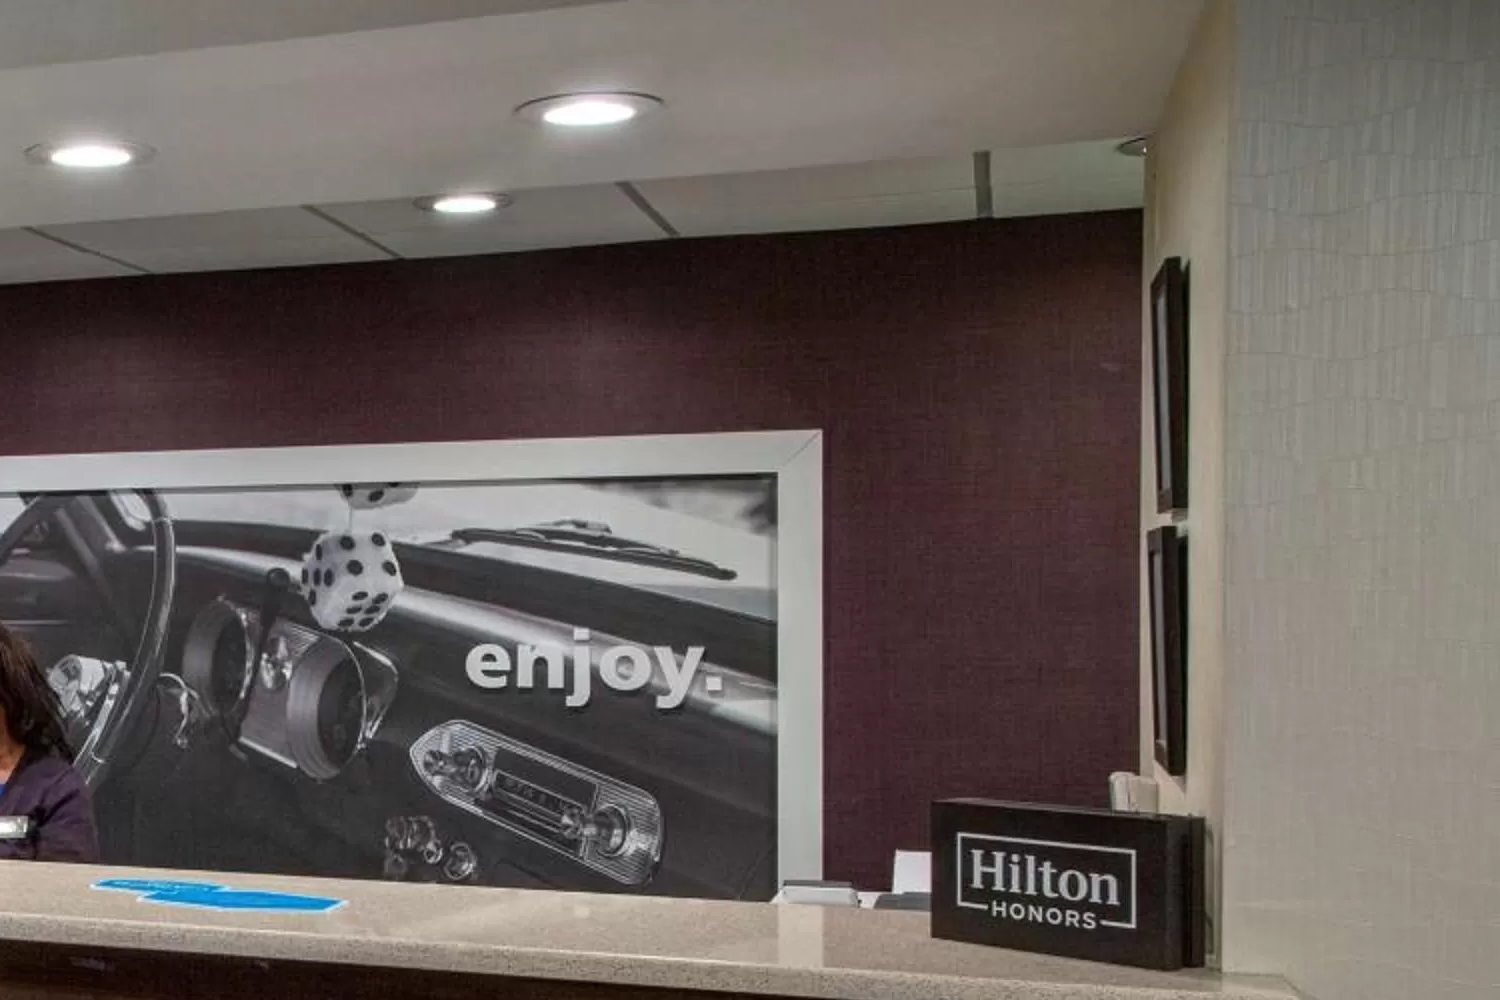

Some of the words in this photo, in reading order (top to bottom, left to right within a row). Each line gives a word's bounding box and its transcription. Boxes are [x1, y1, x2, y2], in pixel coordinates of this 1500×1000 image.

[465, 627, 723, 709] enjoy.
[970, 848, 1121, 906] Hilton
[992, 901, 1097, 930] HONORS
